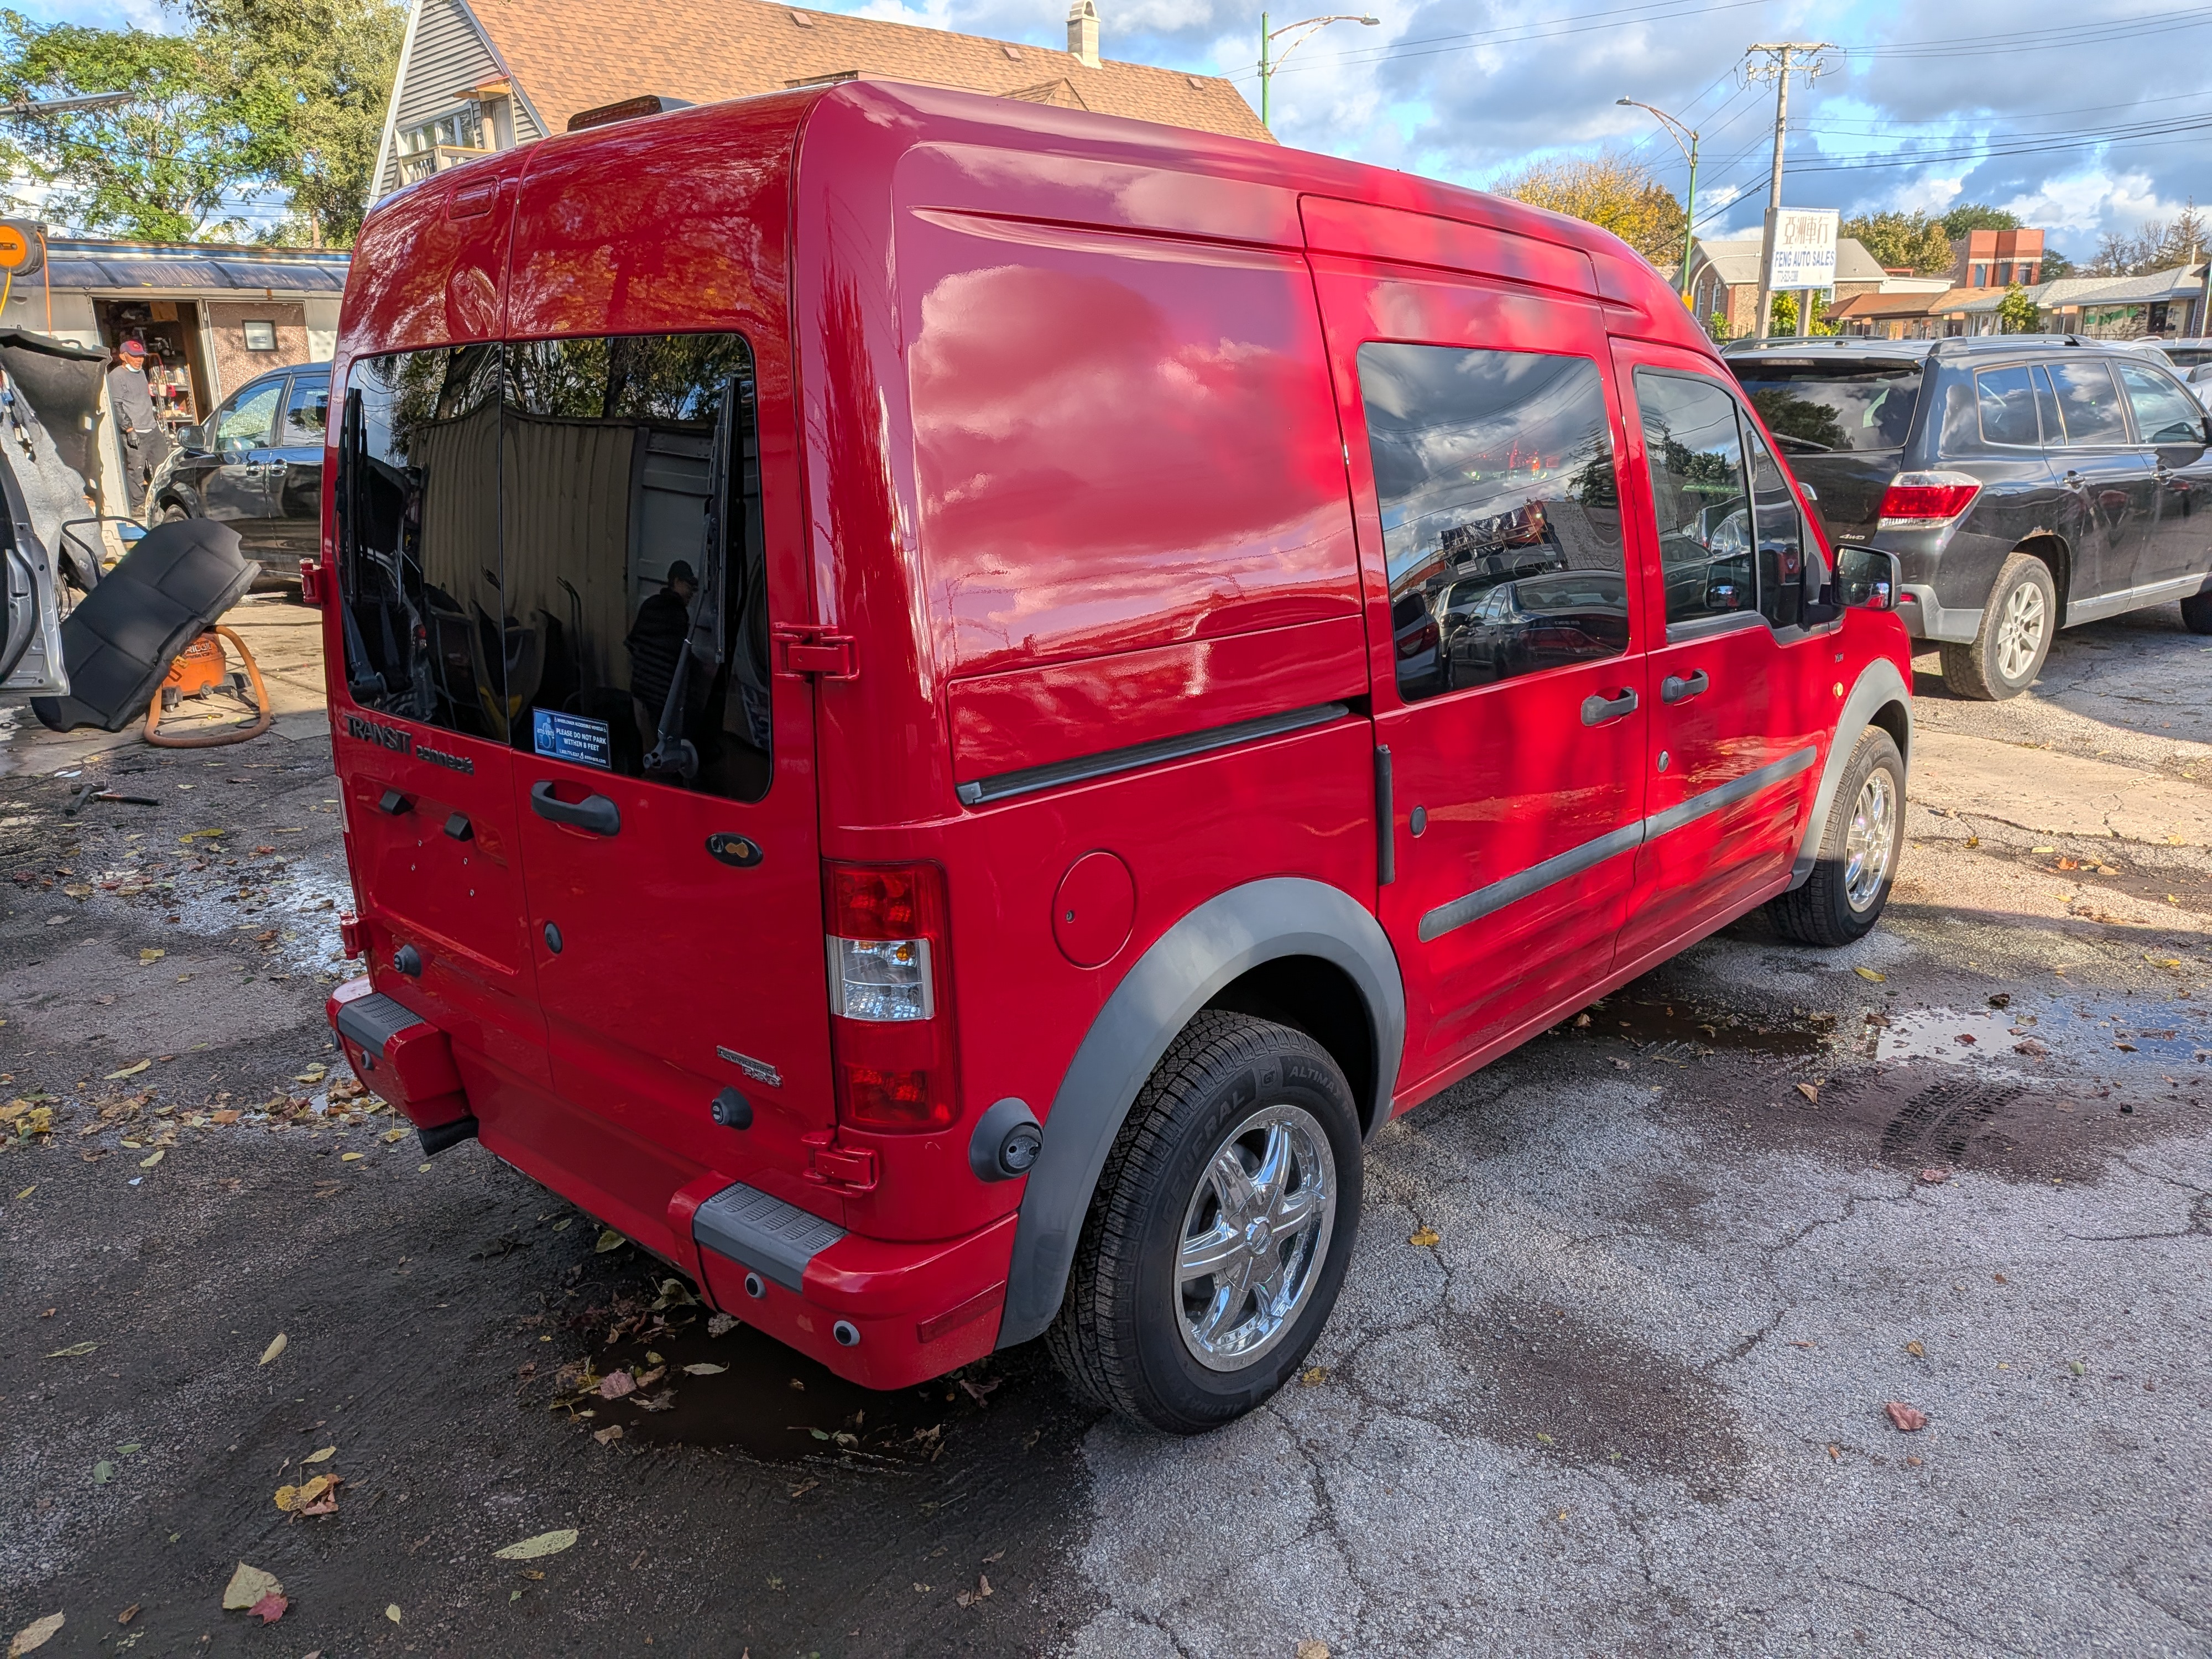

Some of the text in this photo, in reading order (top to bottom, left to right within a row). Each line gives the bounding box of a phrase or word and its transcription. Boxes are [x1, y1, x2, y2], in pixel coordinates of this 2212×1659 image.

[1775, 251, 1835, 268] FENG AUTO SALES
[344, 713, 412, 755] TRANSIT
[556, 728, 607, 745] PLEASE DO NOT PARK
[564, 738, 582, 748] WITHIN
[587, 743, 600, 752] FEET
[1161, 1089, 1246, 1225] GENERAL
